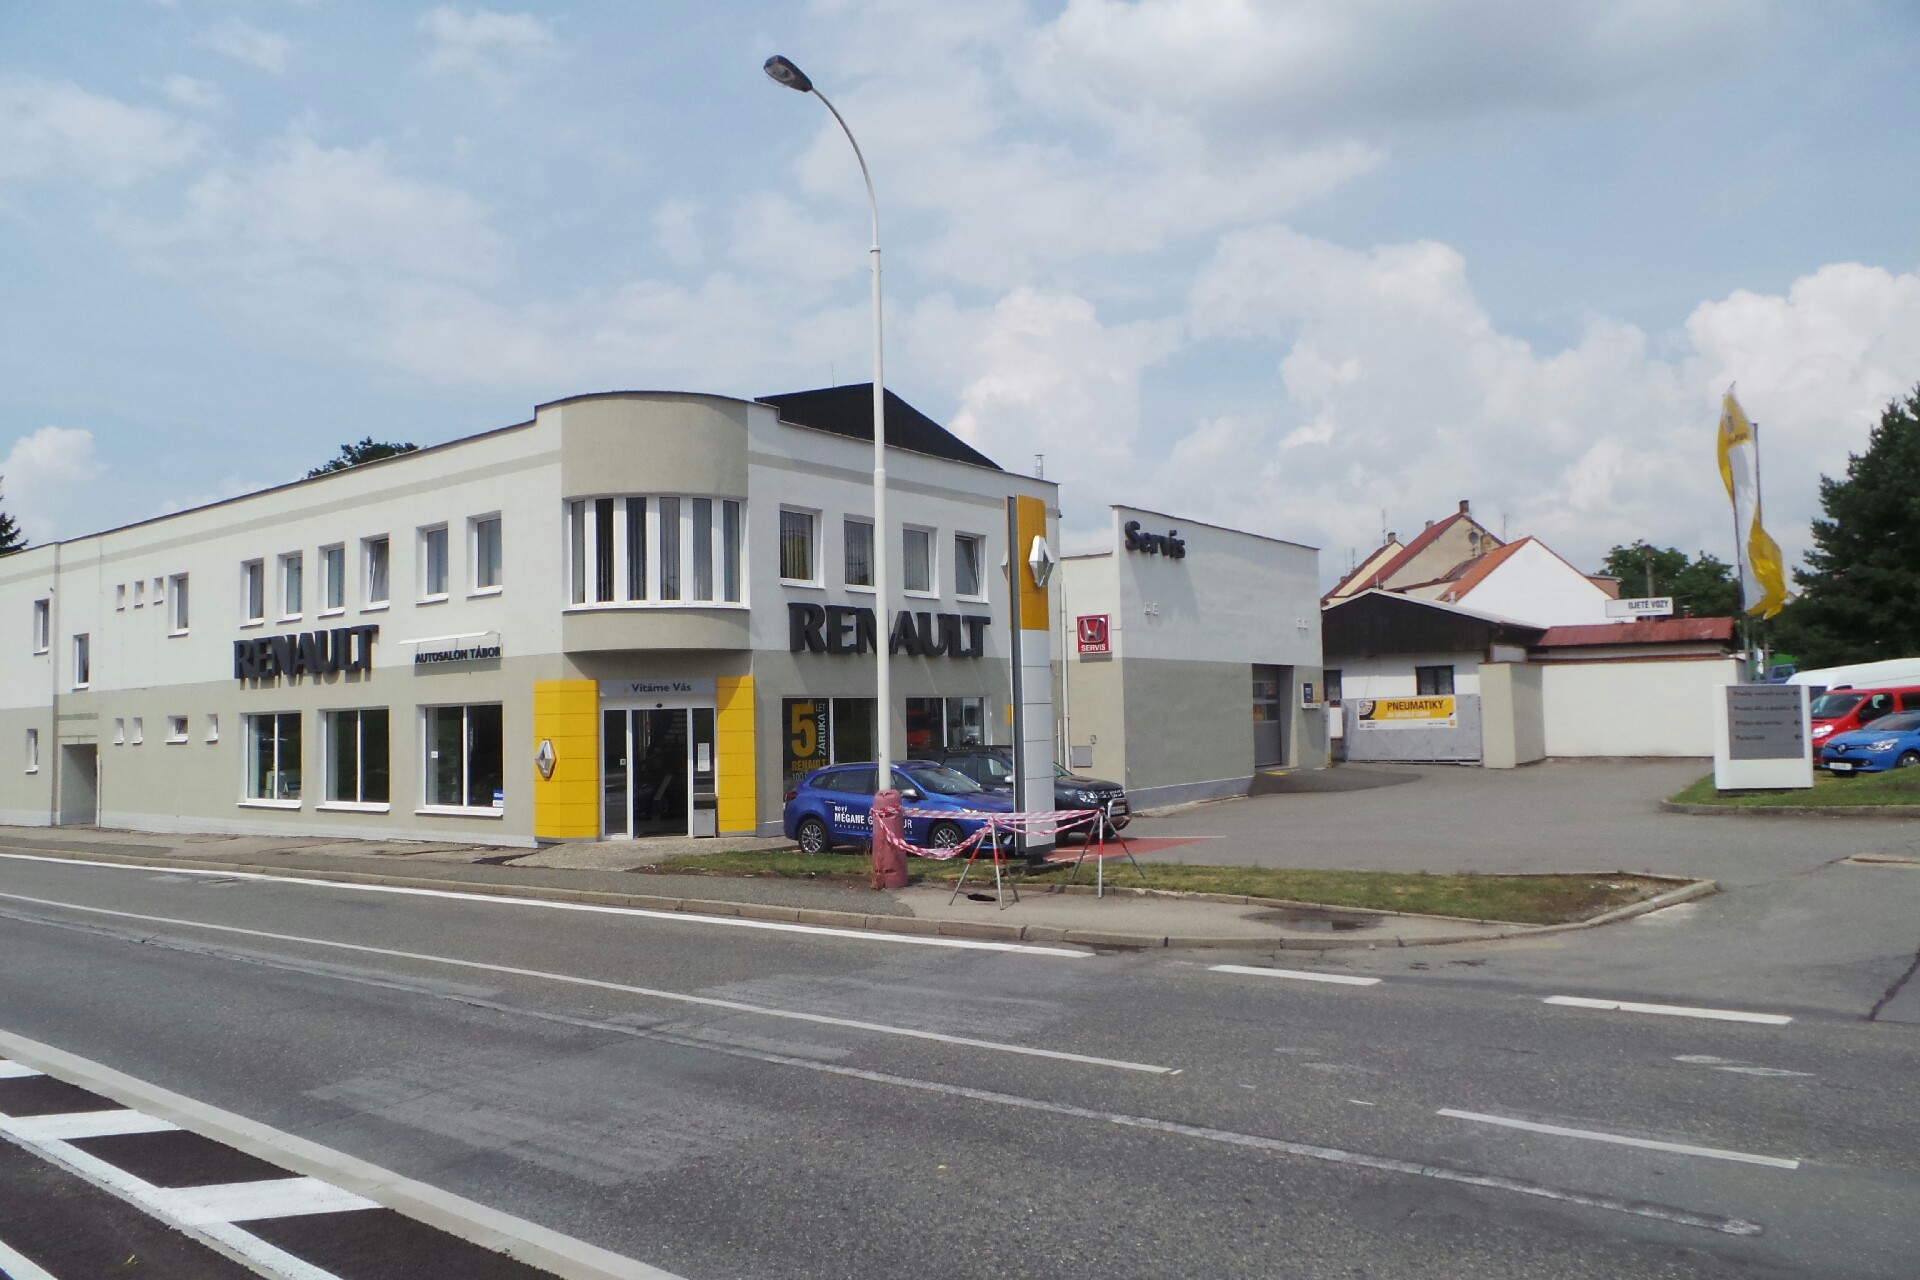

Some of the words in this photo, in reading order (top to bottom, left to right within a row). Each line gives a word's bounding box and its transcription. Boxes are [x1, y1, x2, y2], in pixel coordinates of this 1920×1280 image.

[1125, 521, 1186, 558] Servis
[1651, 600, 1669, 608] VOZY
[787, 602, 991, 657] RENAULT
[233, 624, 379, 679] RENAULT
[415, 649, 468, 663] AUTOSALON
[470, 645, 501, 658] TÁBOR
[673, 682, 691, 691] Vás
[1387, 700, 1444, 710] PNEUMATIKY
[791, 704, 816, 757] 5
[817, 713, 827, 756] ZÁRUKA
[834, 812, 865, 824] MÉGANE
